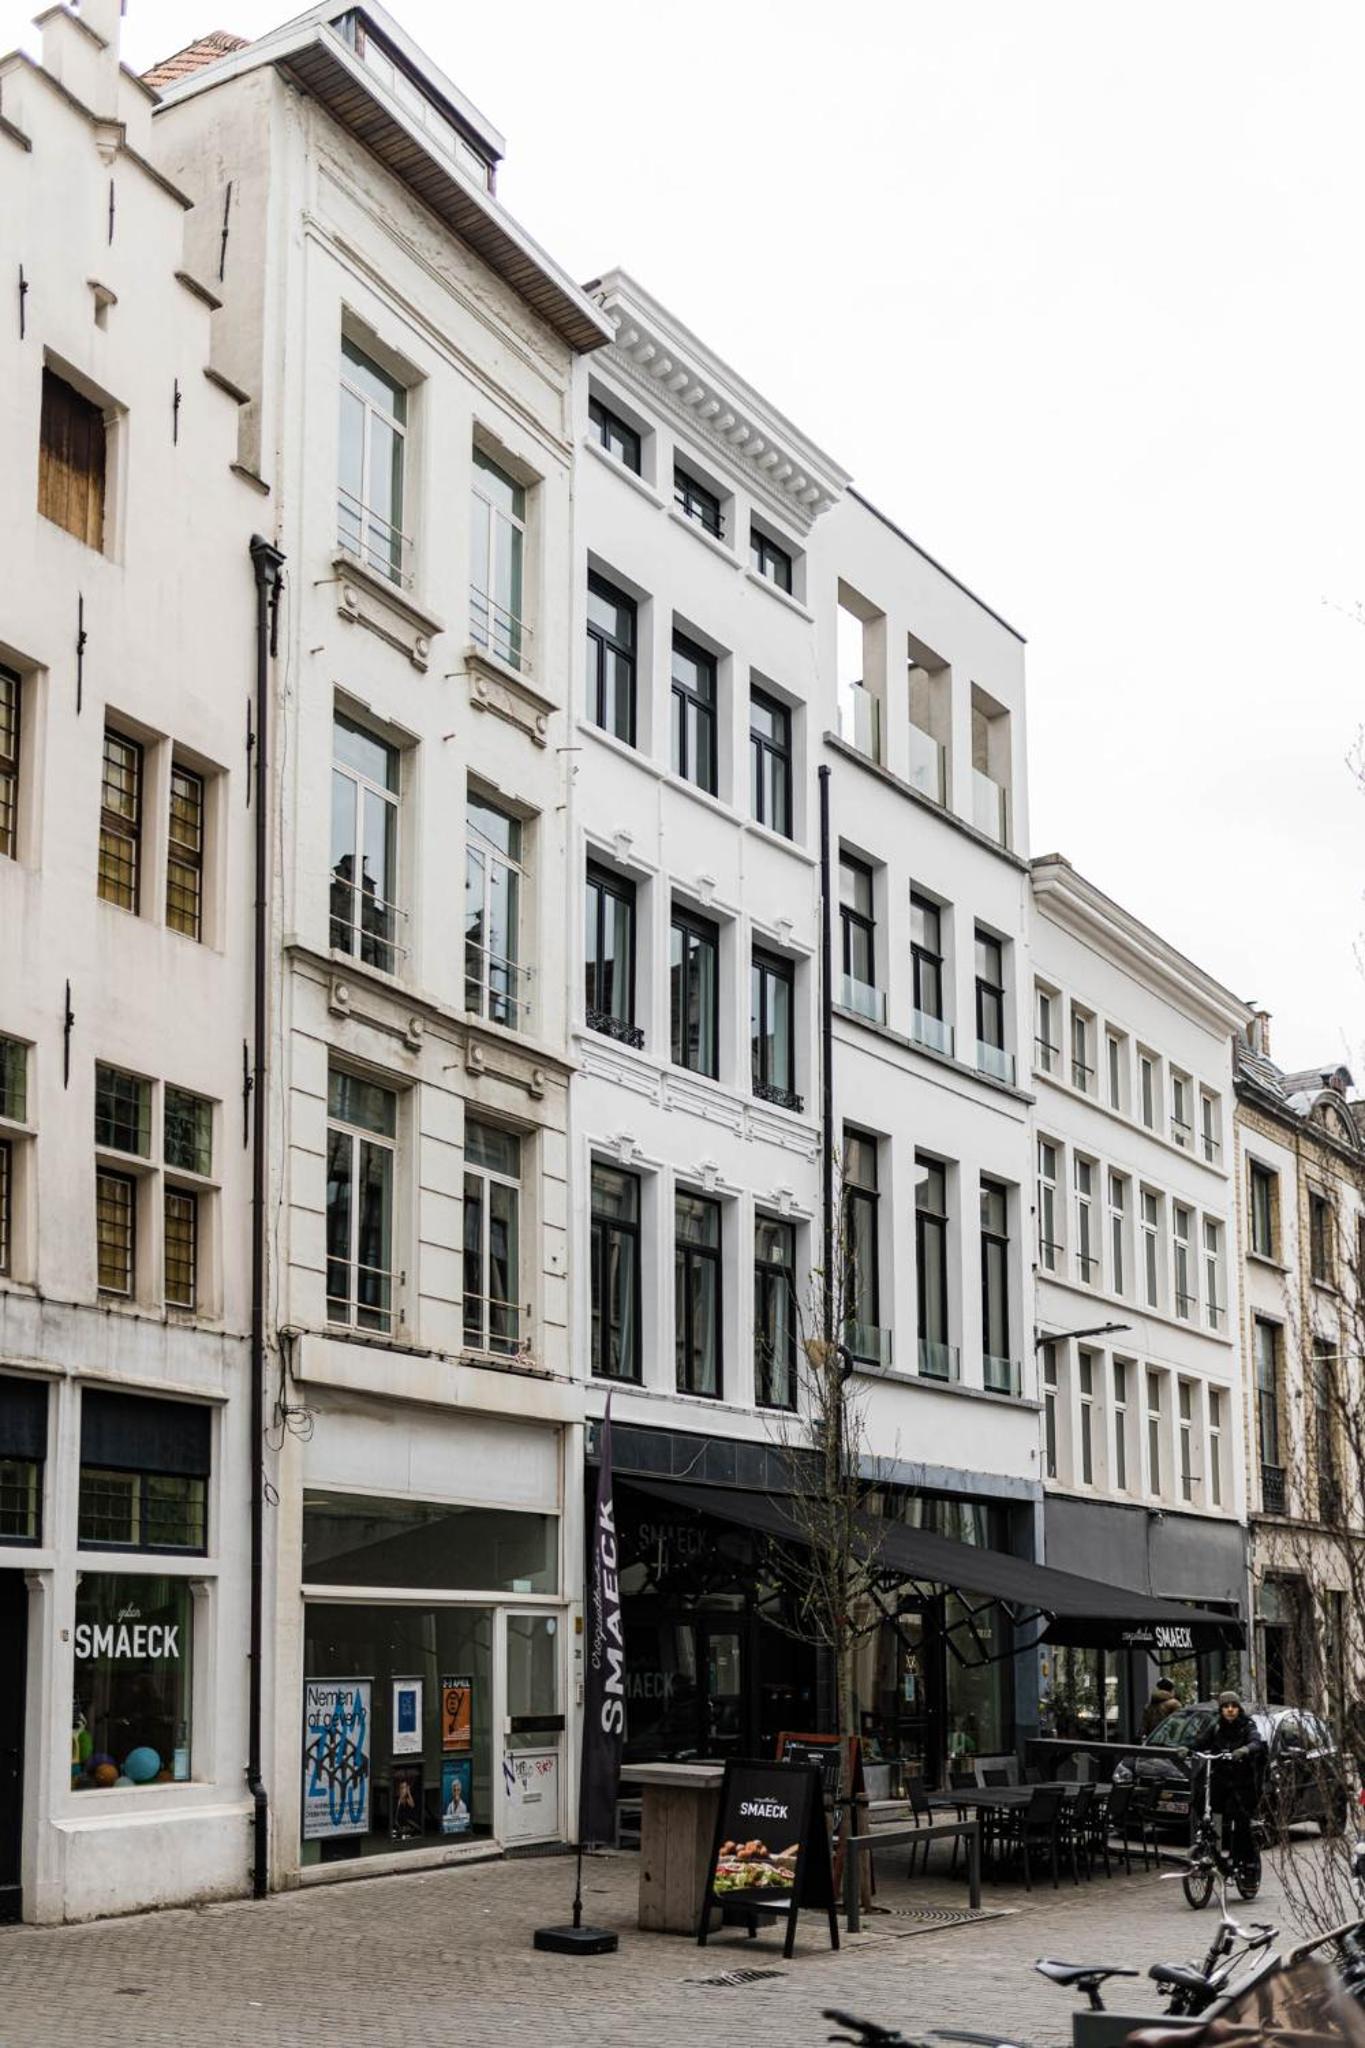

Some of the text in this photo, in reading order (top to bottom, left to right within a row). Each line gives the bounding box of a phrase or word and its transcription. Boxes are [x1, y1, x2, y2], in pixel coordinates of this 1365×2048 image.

[600, 1500, 624, 1735] SMAECK
[76, 1624, 179, 1658] SMAECK
[1155, 1626, 1193, 1648] SMAECK
[308, 1687, 353, 1707] Nemen
[308, 1709, 320, 1728] of
[740, 1802, 788, 1819] SMAECK
